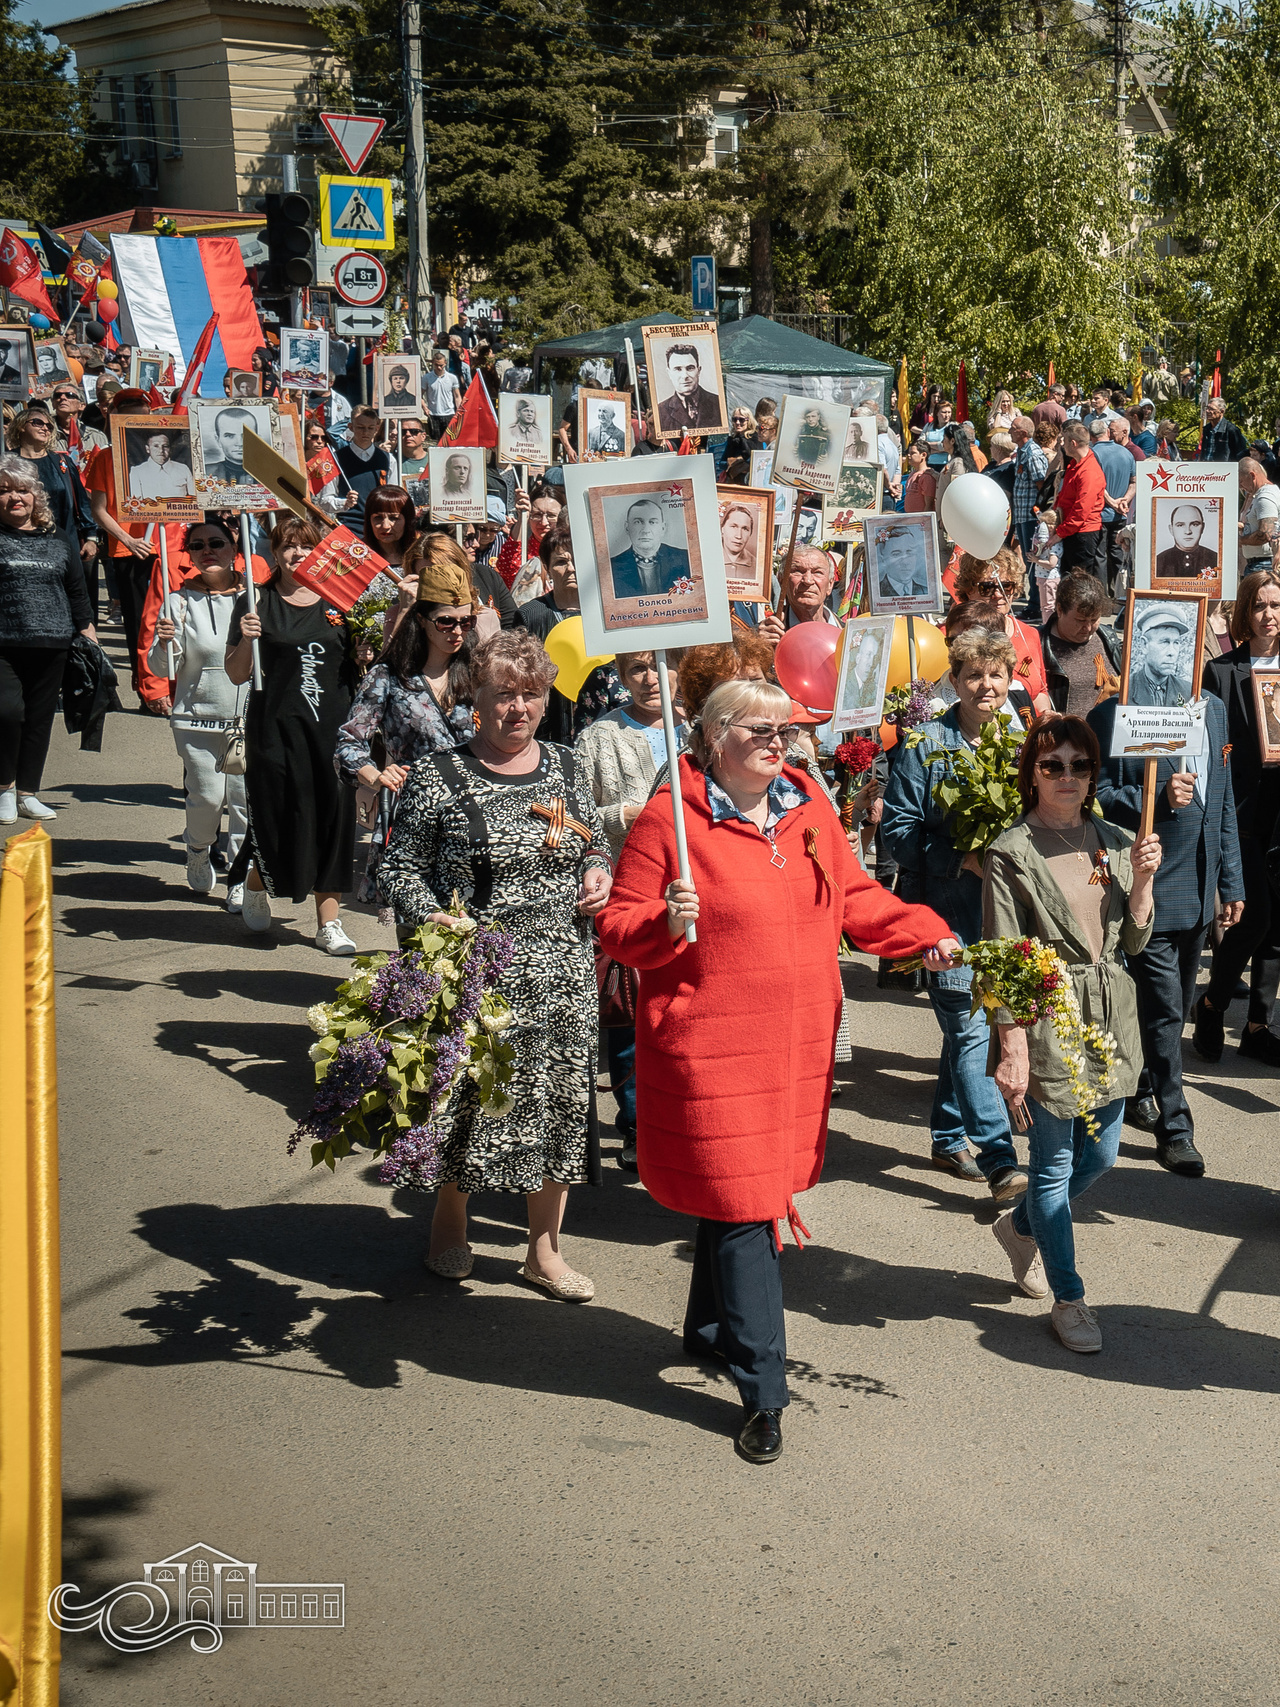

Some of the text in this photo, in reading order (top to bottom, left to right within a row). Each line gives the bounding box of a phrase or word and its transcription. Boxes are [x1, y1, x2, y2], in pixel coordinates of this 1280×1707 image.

[649, 322, 710, 334] БЕССМЕРТНЫЙ
[1176, 483, 1206, 493] ПОЛК
[166, 502, 199, 511] Иванов
[638, 598, 673, 607] Волков
[609, 606, 704, 622] Алексей Андреевич
[1126, 718, 1160, 727] Архипов
[1130, 729, 1187, 740] Илларионович
